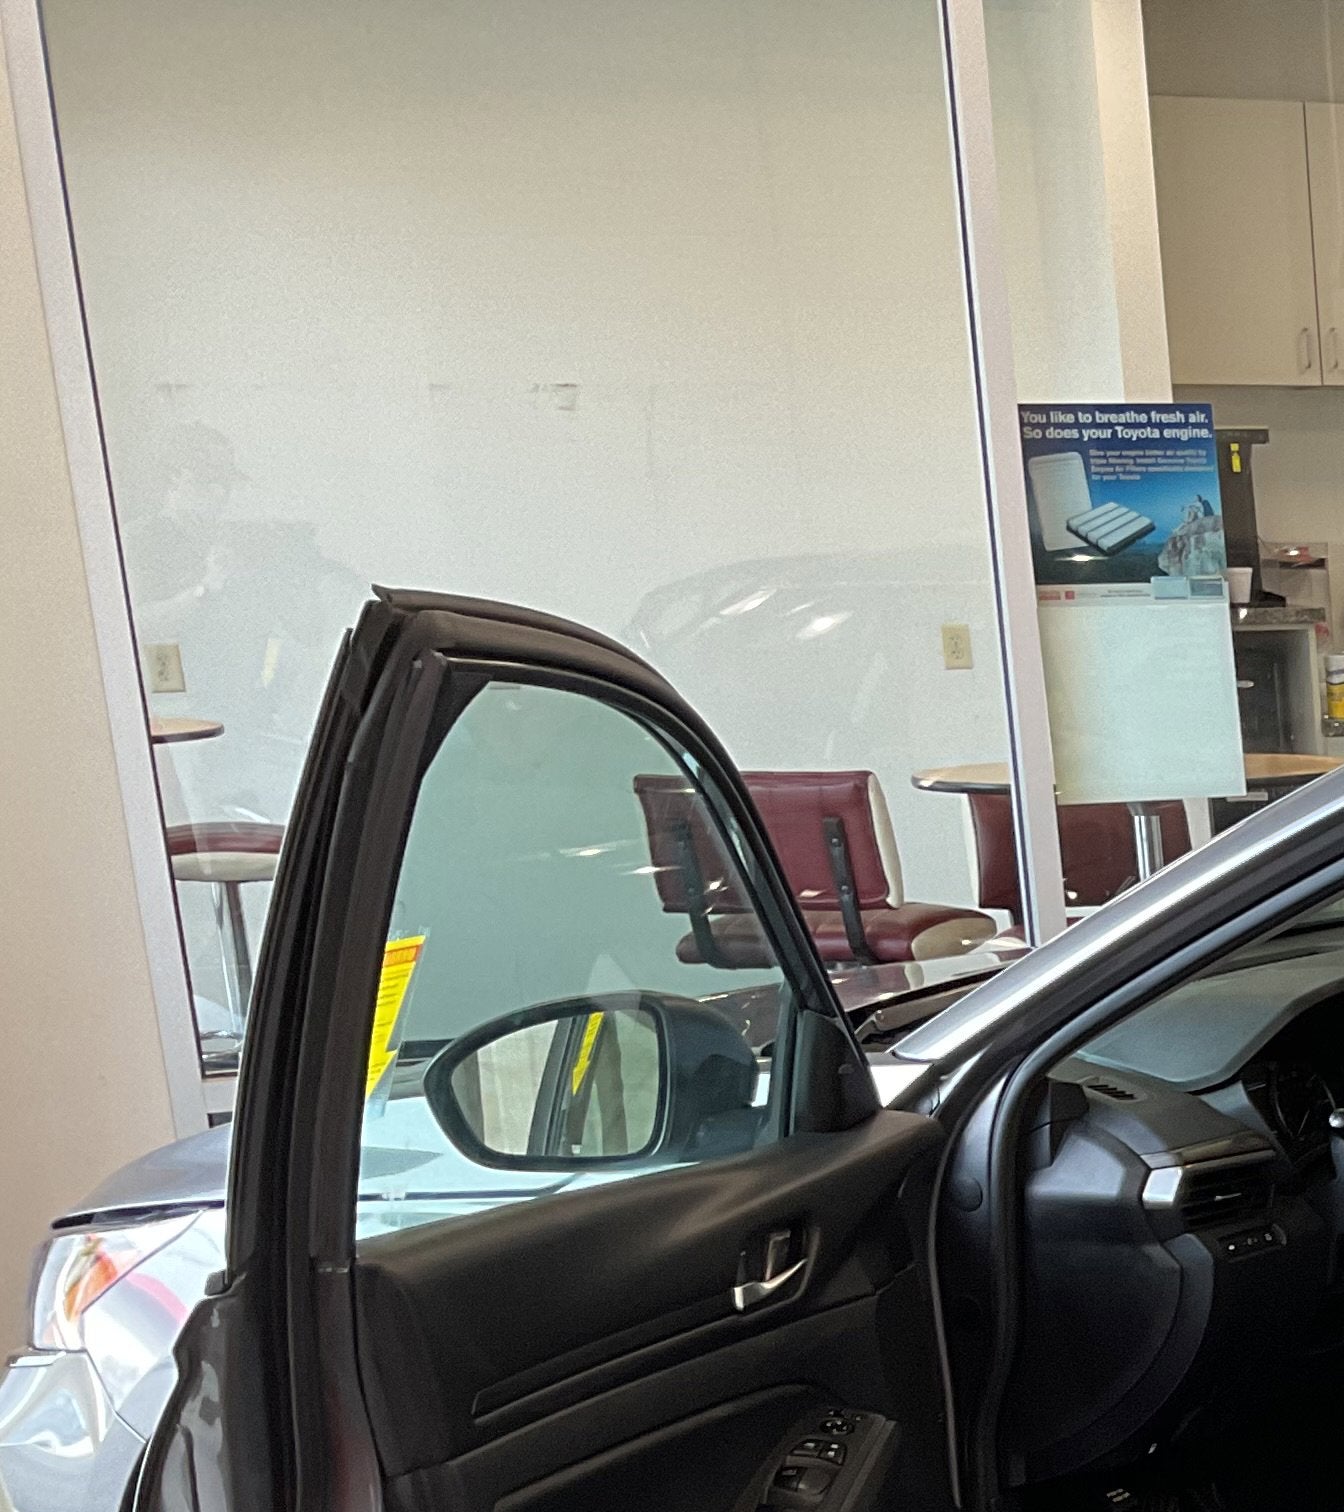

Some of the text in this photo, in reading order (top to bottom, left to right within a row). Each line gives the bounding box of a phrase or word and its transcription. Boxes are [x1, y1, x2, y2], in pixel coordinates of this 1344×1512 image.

[1021, 410, 1208, 423] You like to breathe fresh air.
[1023, 427, 1213, 441] So does your Toyota engine.
